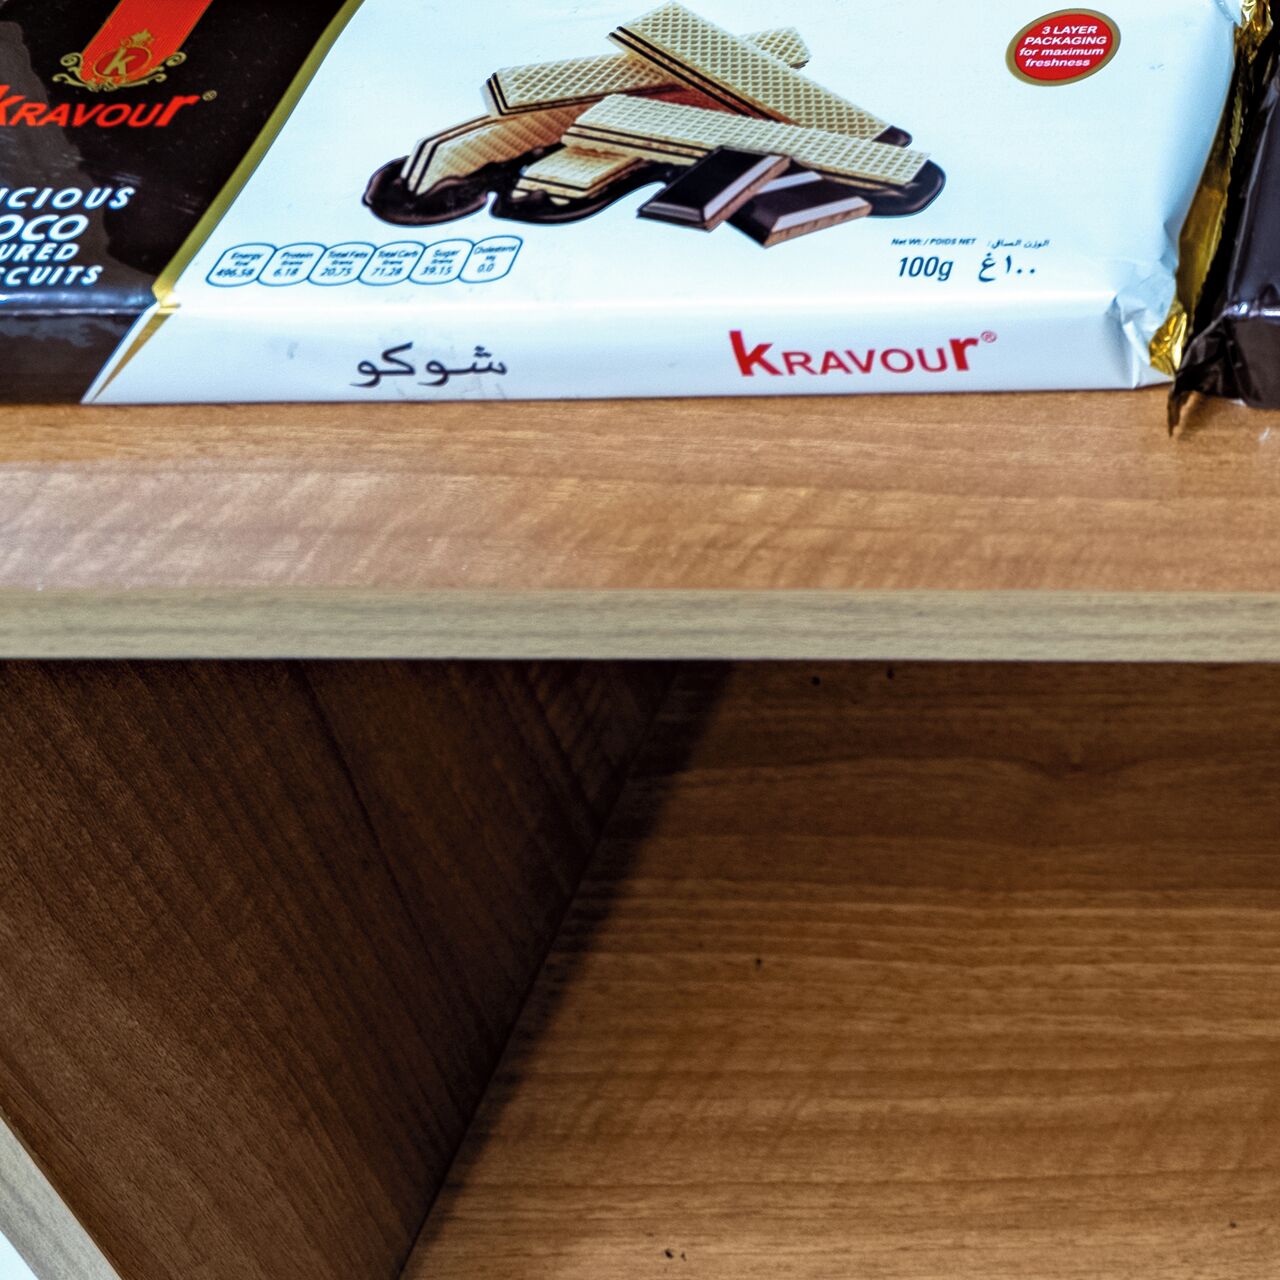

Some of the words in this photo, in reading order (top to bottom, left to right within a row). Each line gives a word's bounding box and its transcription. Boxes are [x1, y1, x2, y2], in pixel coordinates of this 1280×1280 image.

[1042, 25, 1051, 35] 3
[1053, 25, 1098, 35] LAYER
[1024, 36, 1107, 46] PACKAGING
[1019, 47, 1039, 57] for
[1041, 47, 1104, 56] maximum
[1025, 58, 1091, 67] freshness
[898, 256, 954, 282] 100g
[351, 342, 508, 387] شوكو
